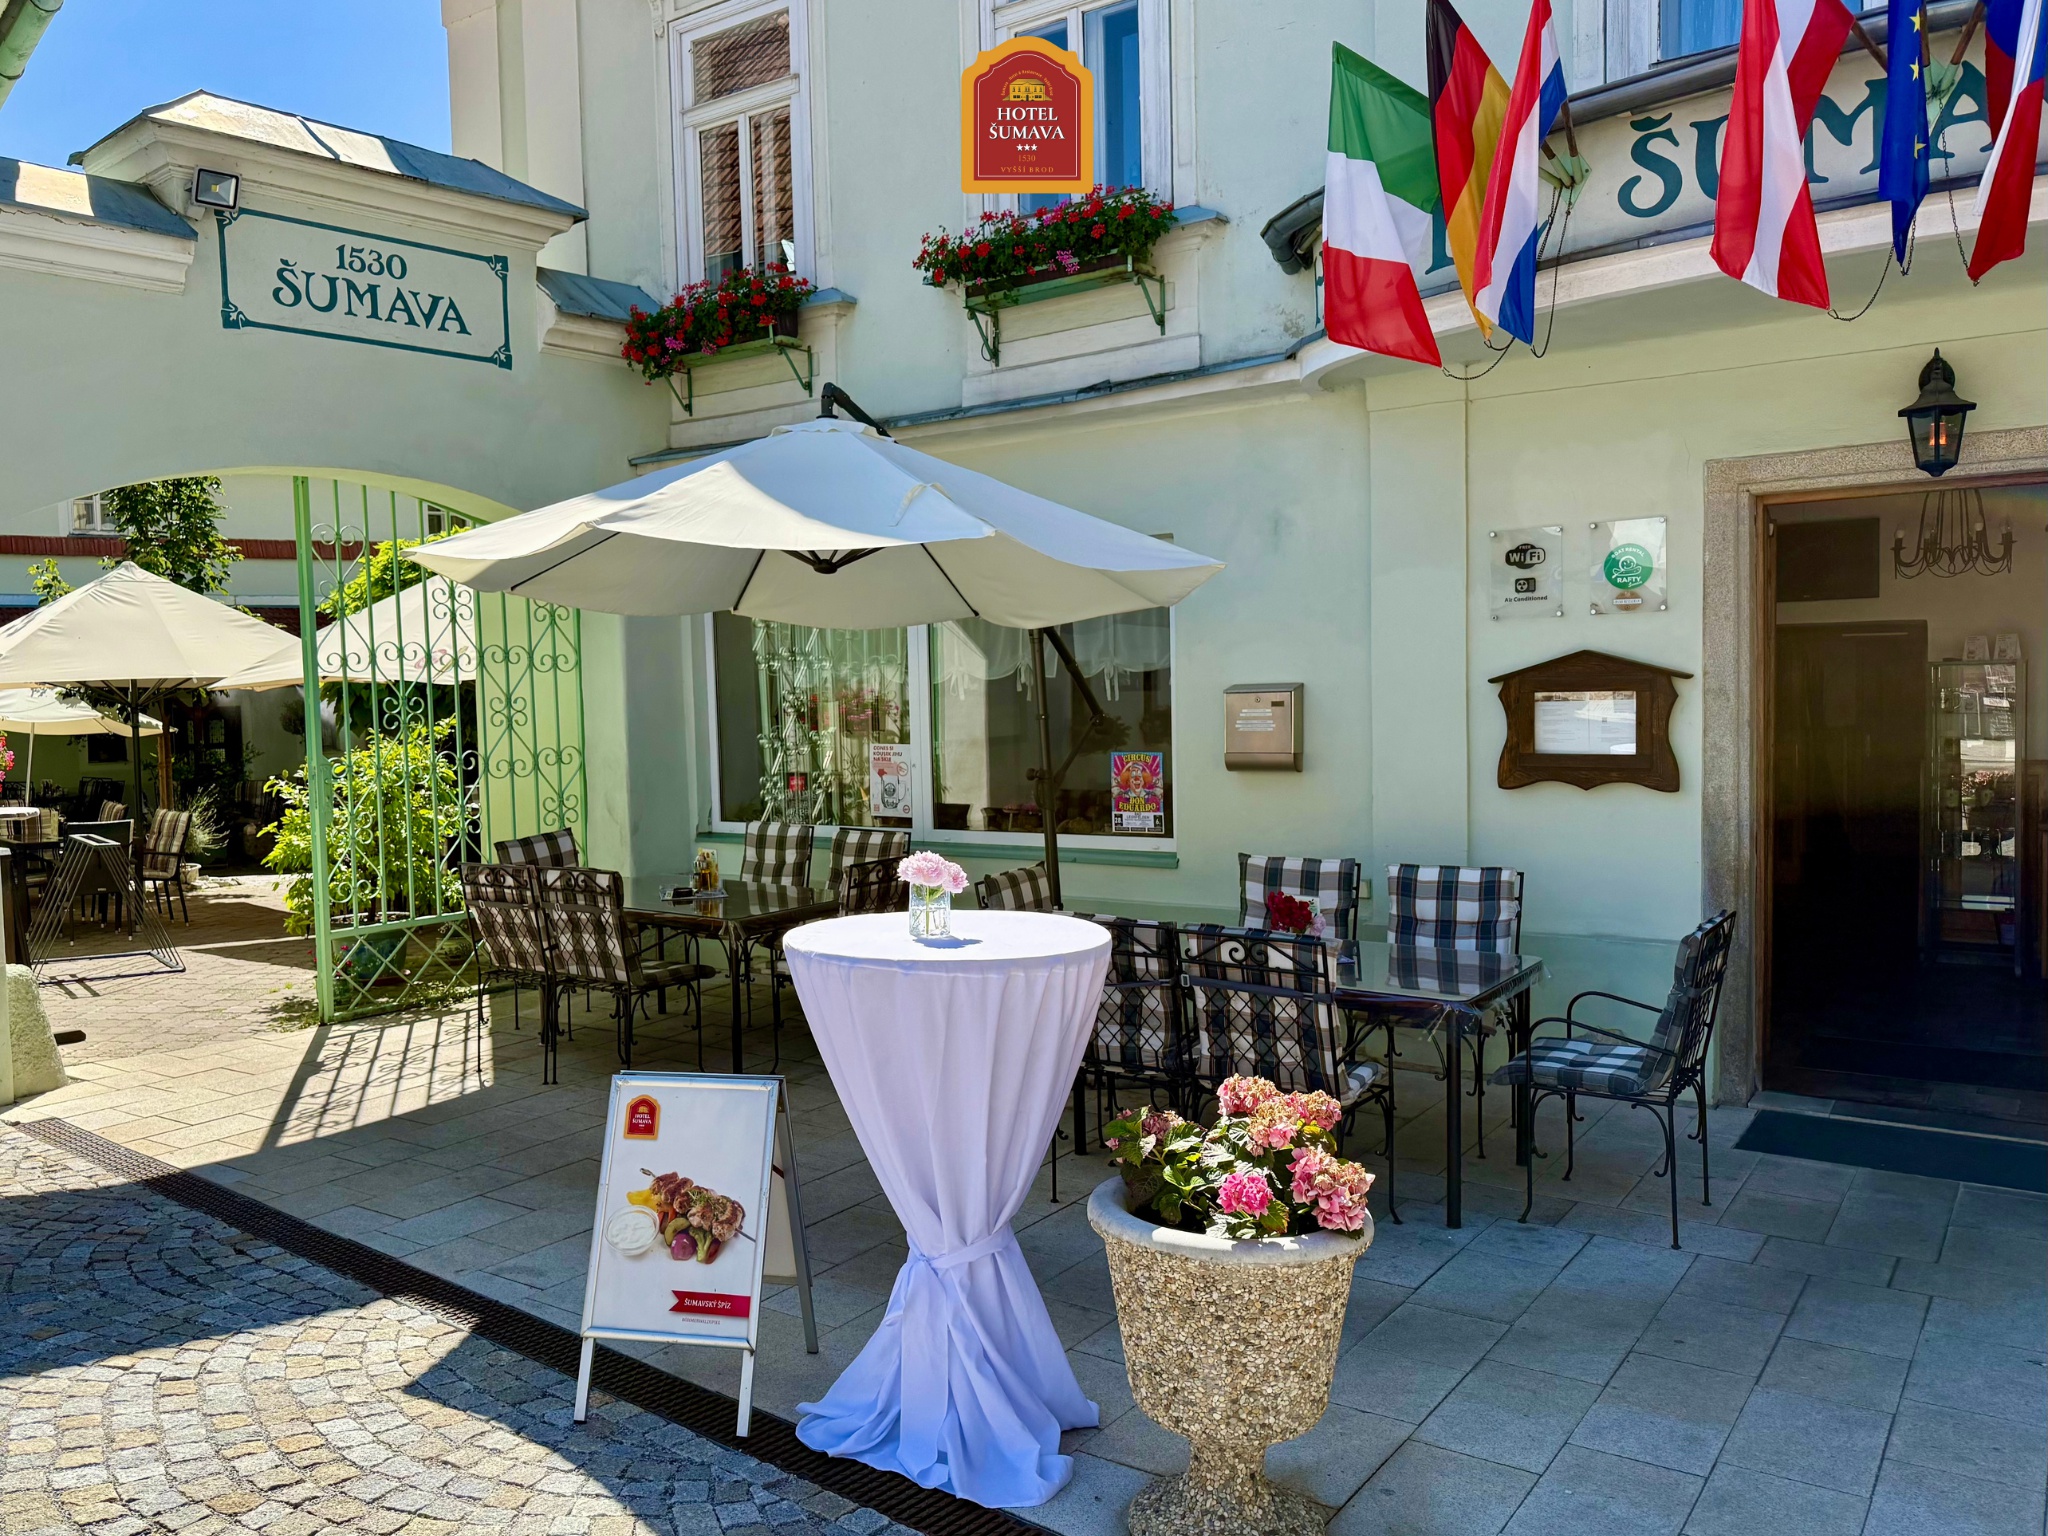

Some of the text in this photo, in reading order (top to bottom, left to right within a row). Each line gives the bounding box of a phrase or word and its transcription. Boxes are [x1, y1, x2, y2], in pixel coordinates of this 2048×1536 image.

[336, 243, 408, 280] 1530
[272, 258, 472, 335] ŠUMAVA
[1514, 595, 1548, 603] Conditioned
[1123, 753, 1151, 763] CIRCUS
[1129, 796, 1145, 804] DON
[1119, 801, 1156, 812] EDUARDO
[684, 1297, 717, 1308] ŠUMAVSKÝ
